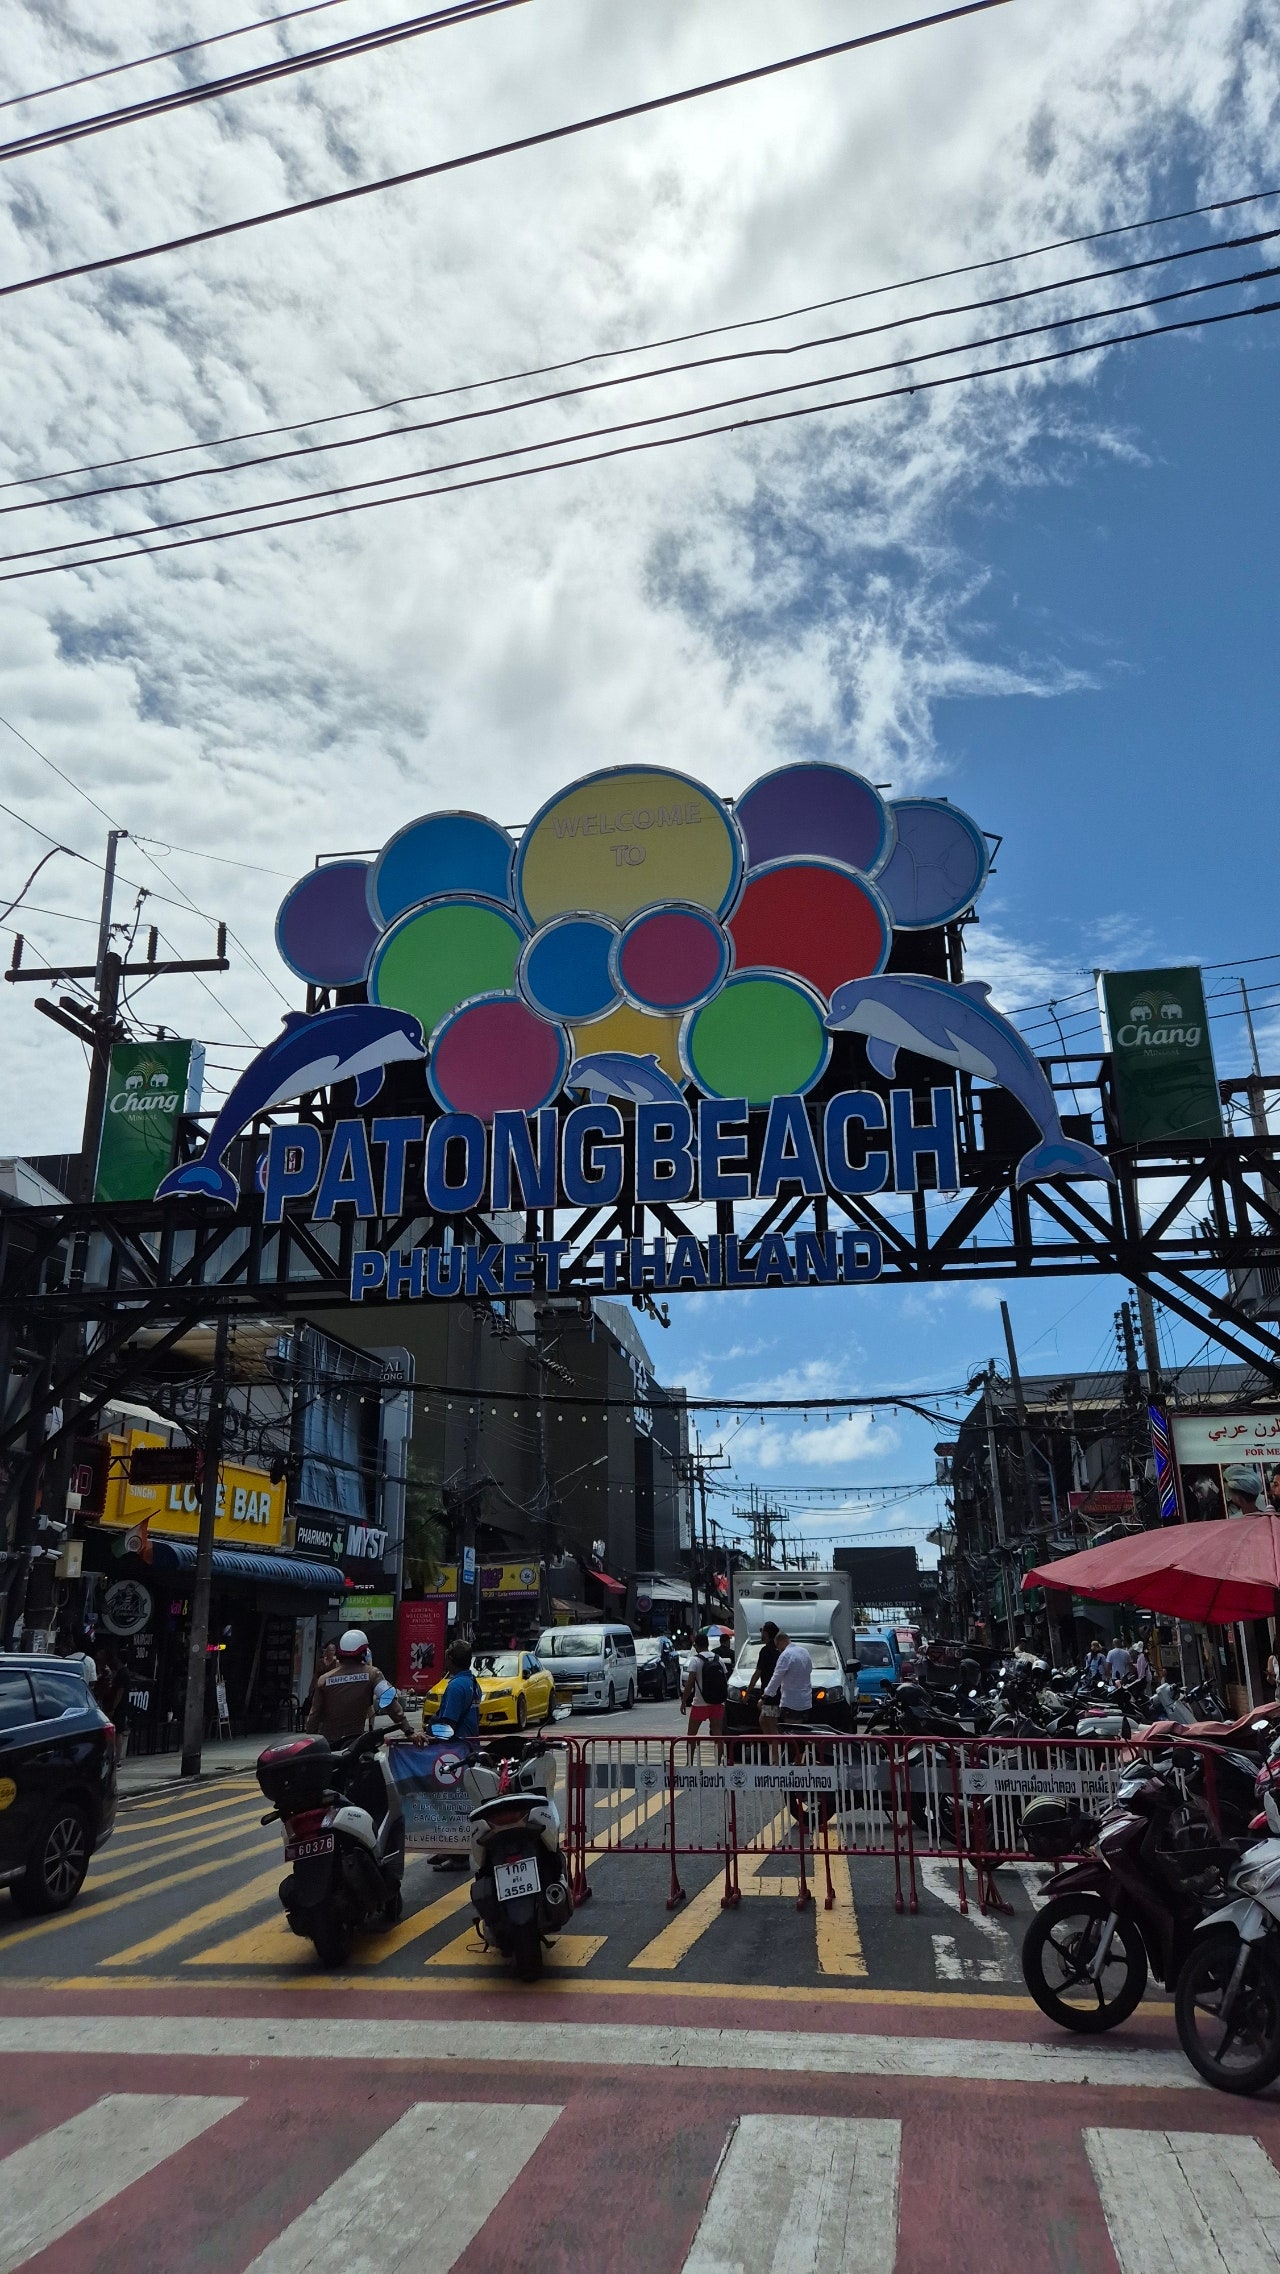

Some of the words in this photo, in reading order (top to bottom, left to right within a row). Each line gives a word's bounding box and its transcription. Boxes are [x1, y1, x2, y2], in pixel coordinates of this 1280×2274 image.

[552, 801, 701, 838] WELCOME
[610, 845, 647, 867] TO
[1116, 1024, 1202, 1048] Chang
[109, 1092, 180, 1114] Chang
[262, 1102, 625, 1224] PATONG
[634, 1086, 961, 1205] BEACH
[350, 1240, 571, 1302] PHUKET
[593, 1228, 884, 1291] THAILAND
[1208, 1424, 1248, 1442] عربي
[1245, 1448, 1264, 1456] FOR
[168, 1483, 226, 1517] LOE
[233, 1487, 272, 1525] BAR
[297, 1527, 333, 1547] PHARMACY
[346, 1524, 389, 1560] MYST
[738, 1589, 750, 1597] 79
[327, 1675, 348, 1685] TRAFFIC
[349, 1672, 368, 1682] POLICE
[298, 1837, 332, 1856] 60376
[420, 1834, 459, 1843] VEHICLES
[504, 1882, 534, 1898] 3558
